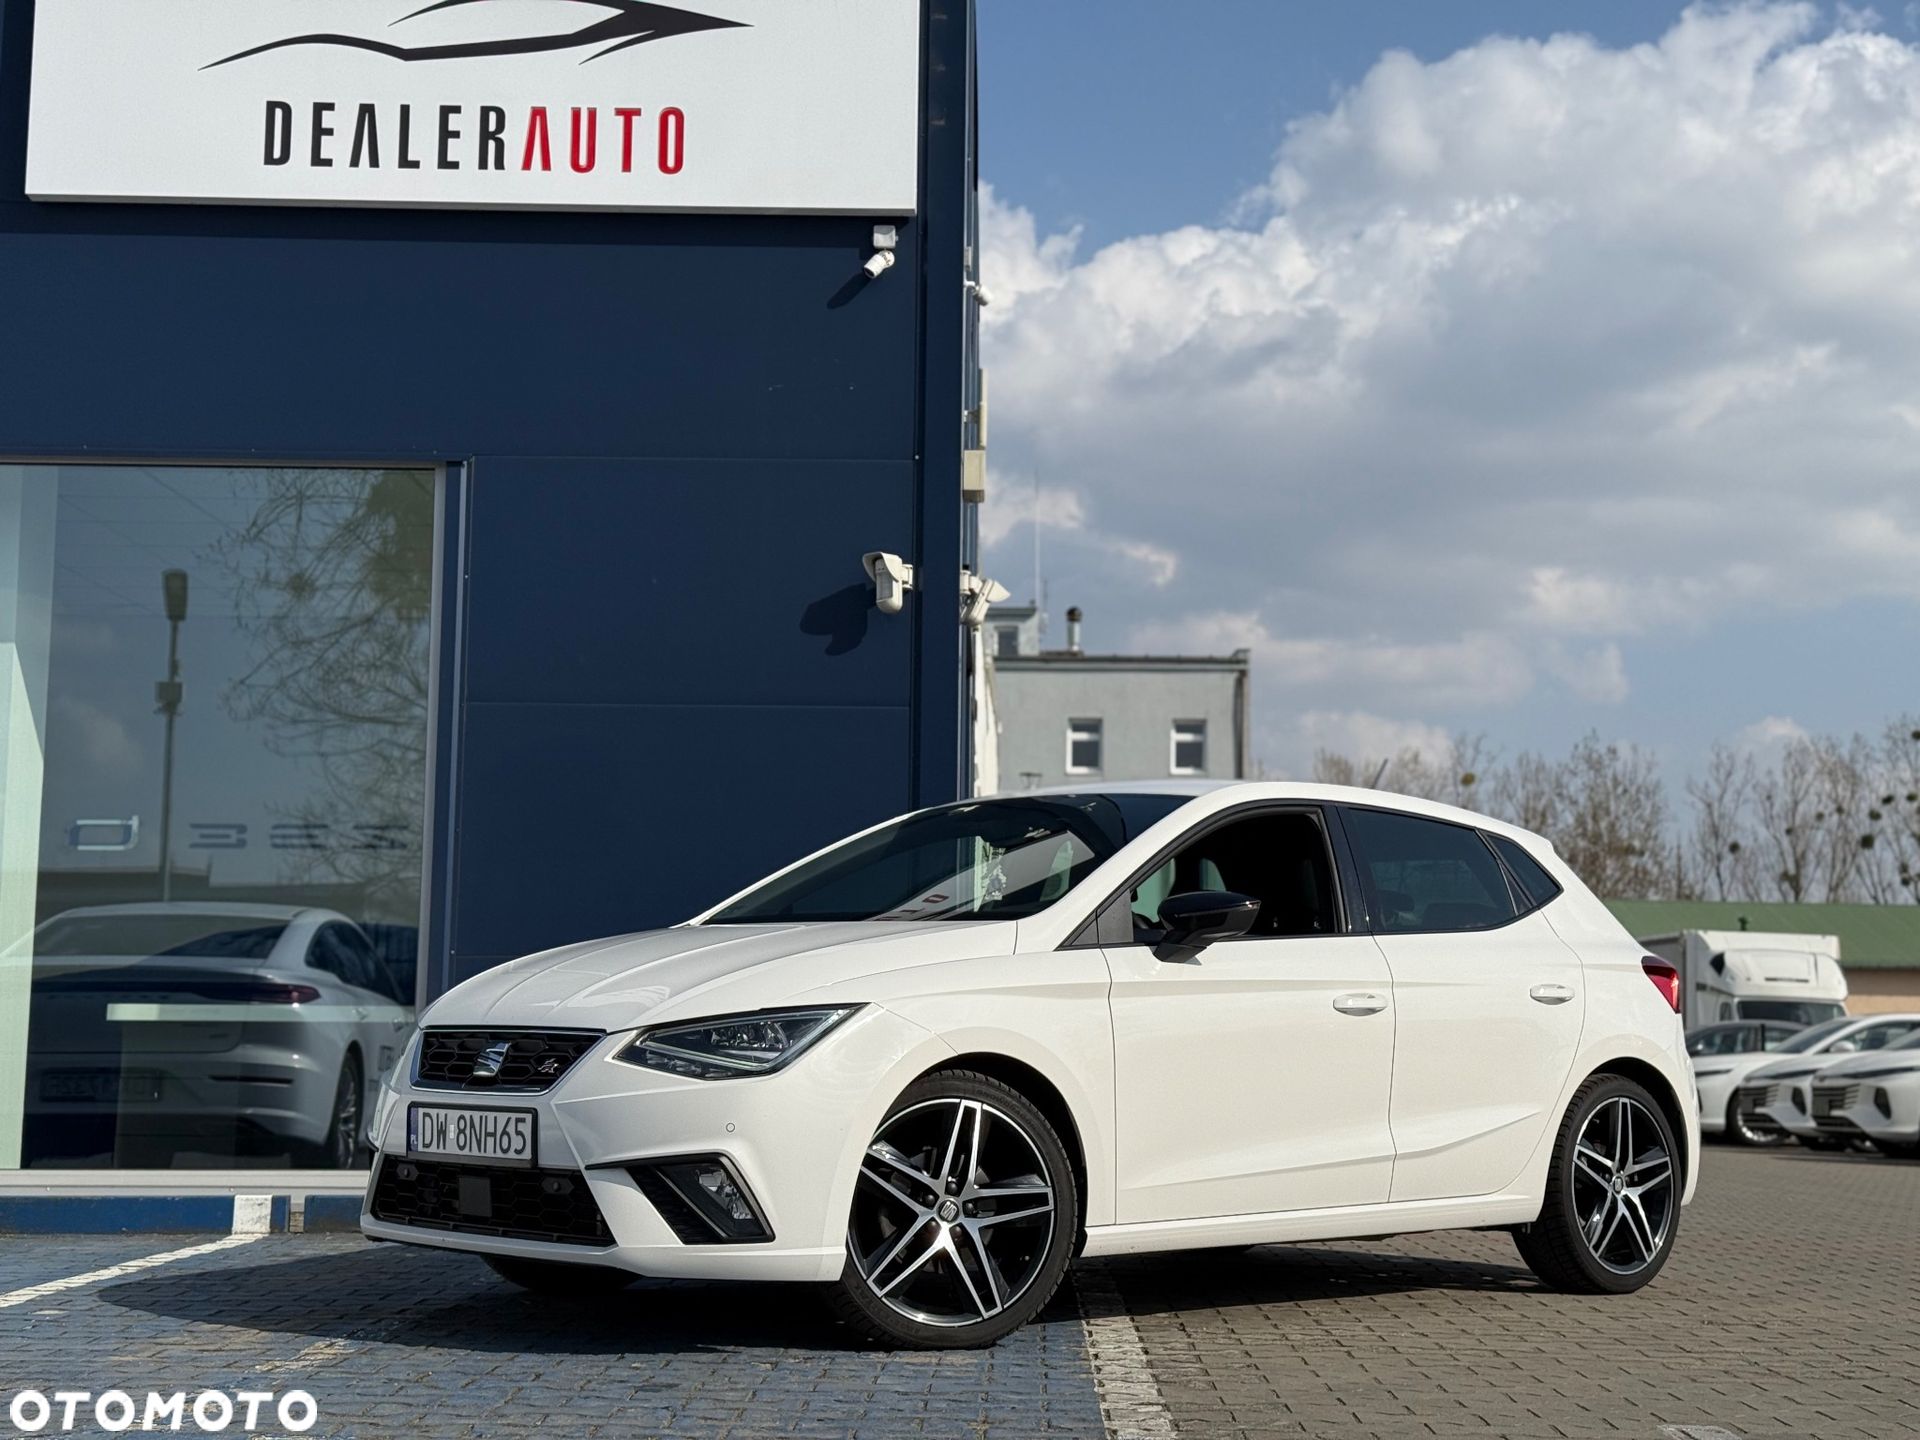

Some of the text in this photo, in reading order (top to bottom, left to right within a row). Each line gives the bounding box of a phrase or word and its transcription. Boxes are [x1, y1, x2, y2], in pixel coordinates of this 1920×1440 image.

[264, 100, 685, 174] DEALERAUTO
[422, 1112, 527, 1155] DW 8NH65
